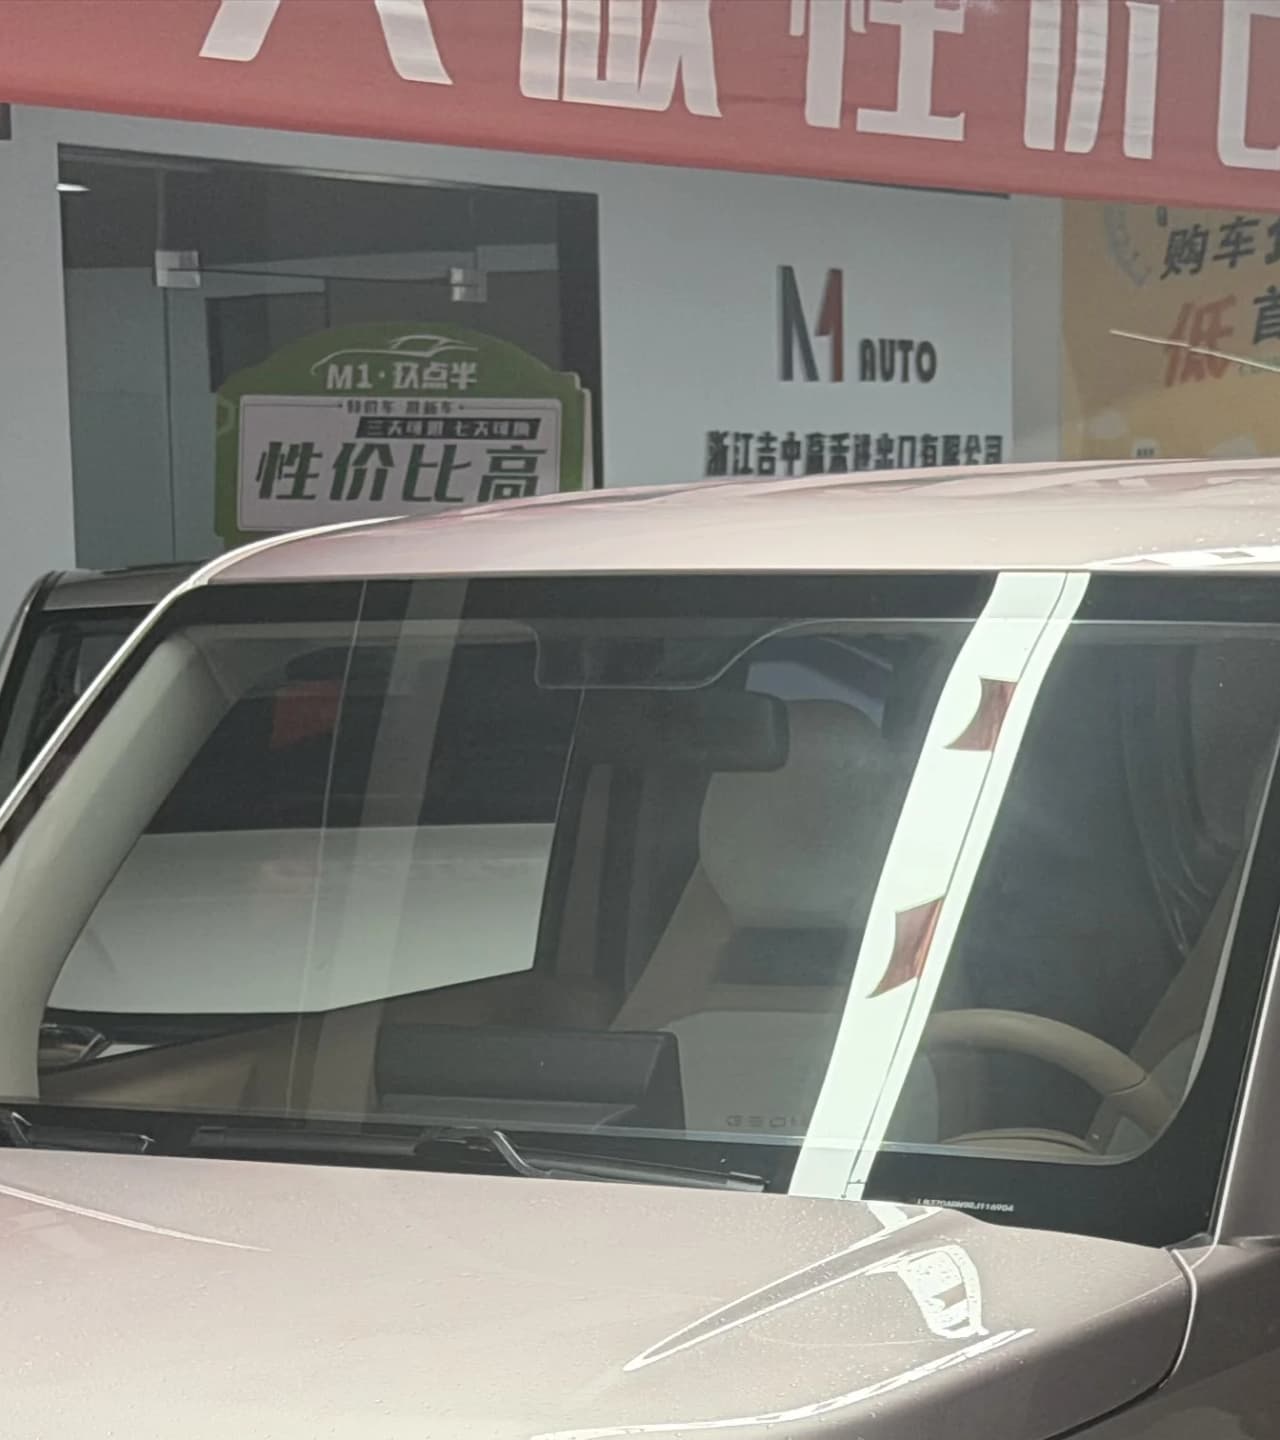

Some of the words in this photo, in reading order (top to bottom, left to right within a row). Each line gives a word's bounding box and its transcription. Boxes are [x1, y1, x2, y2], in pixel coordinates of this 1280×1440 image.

[326, 362, 478, 391] M1·玖点半
[858, 338, 937, 383] AUTO
[255, 441, 548, 503] 性价比高
